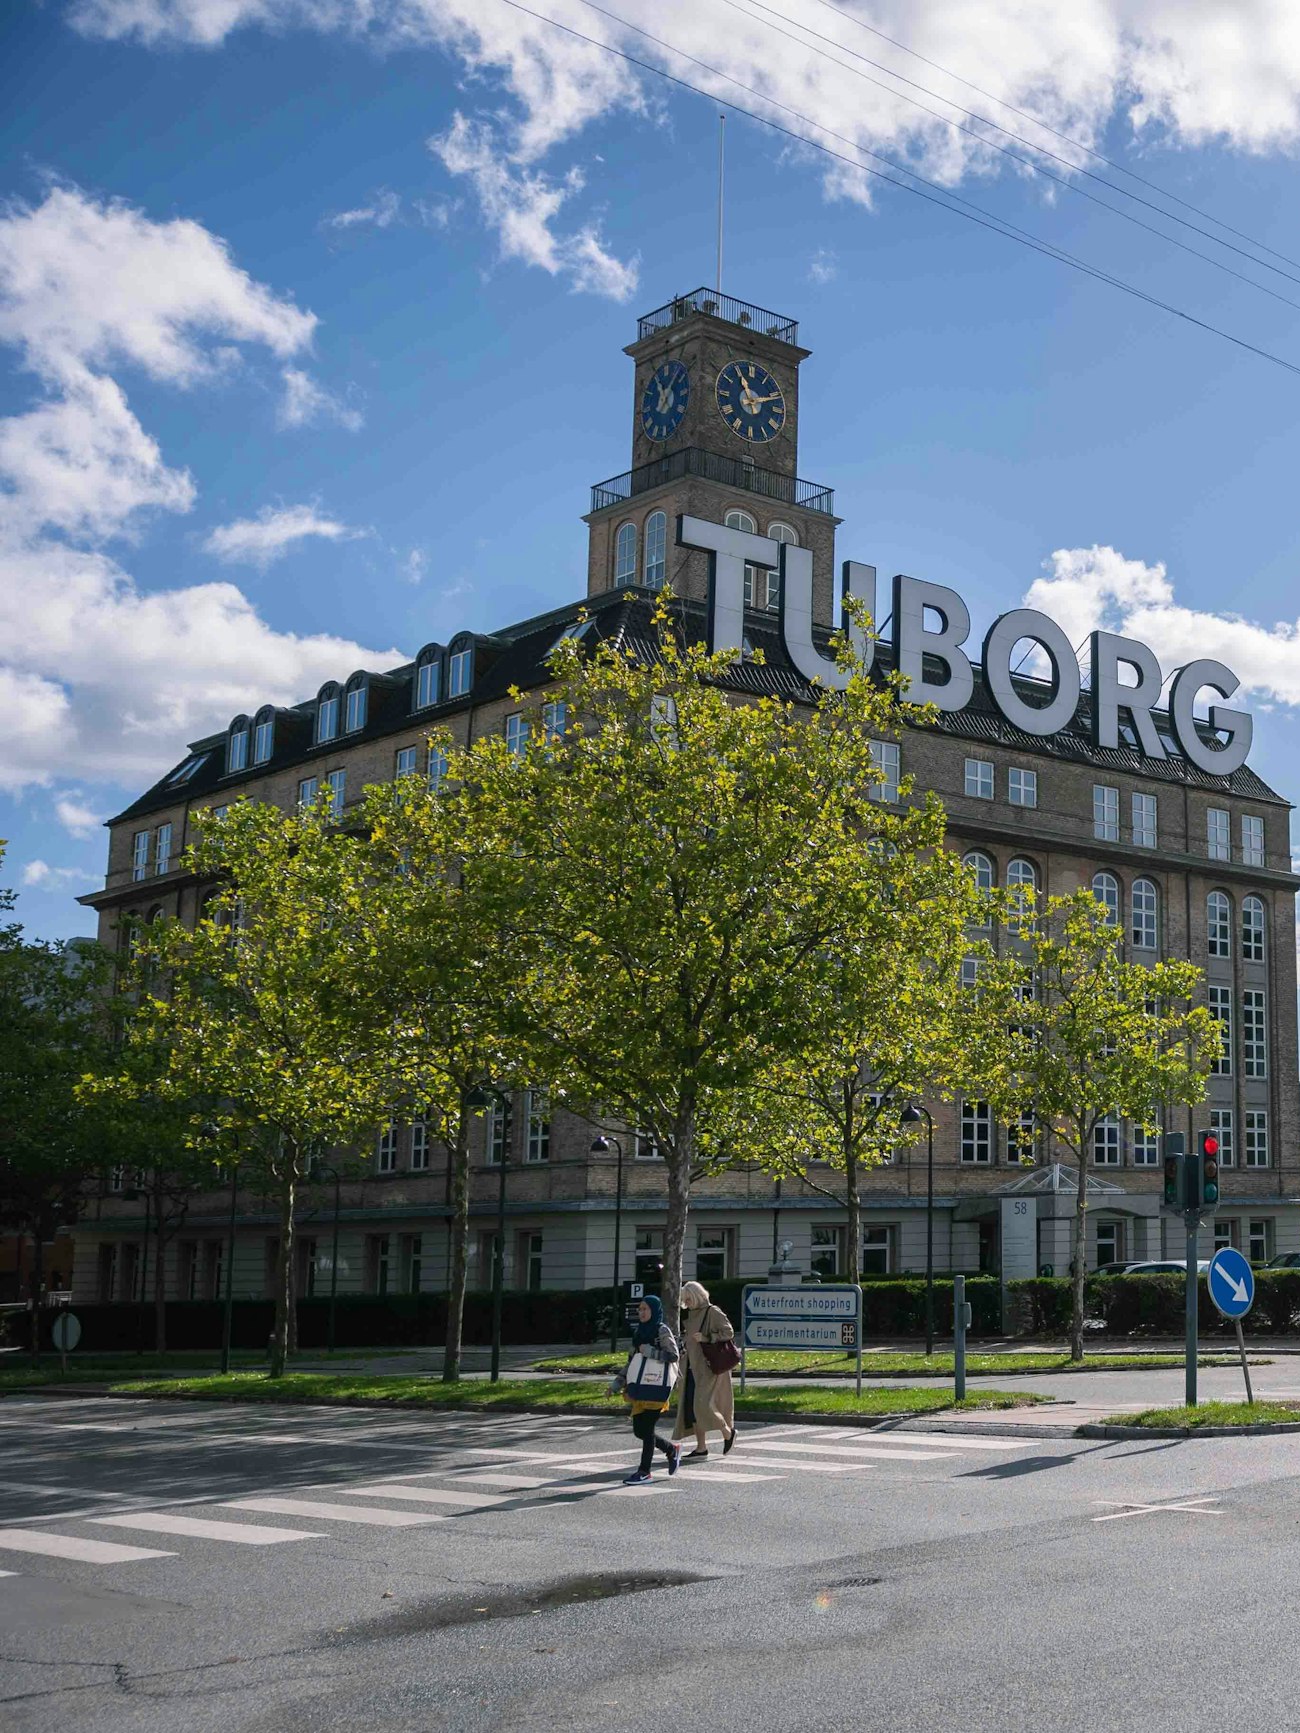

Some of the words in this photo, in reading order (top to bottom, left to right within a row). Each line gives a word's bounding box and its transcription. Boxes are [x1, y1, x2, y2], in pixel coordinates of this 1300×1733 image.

[676, 514, 1252, 775] TUBORG
[1014, 1201, 1027, 1215] 58
[634, 1285, 641, 1296] P
[752, 1297, 804, 1308] Waterfront
[807, 1298, 851, 1311] shopping
[757, 1326, 837, 1339] Experimentarium
